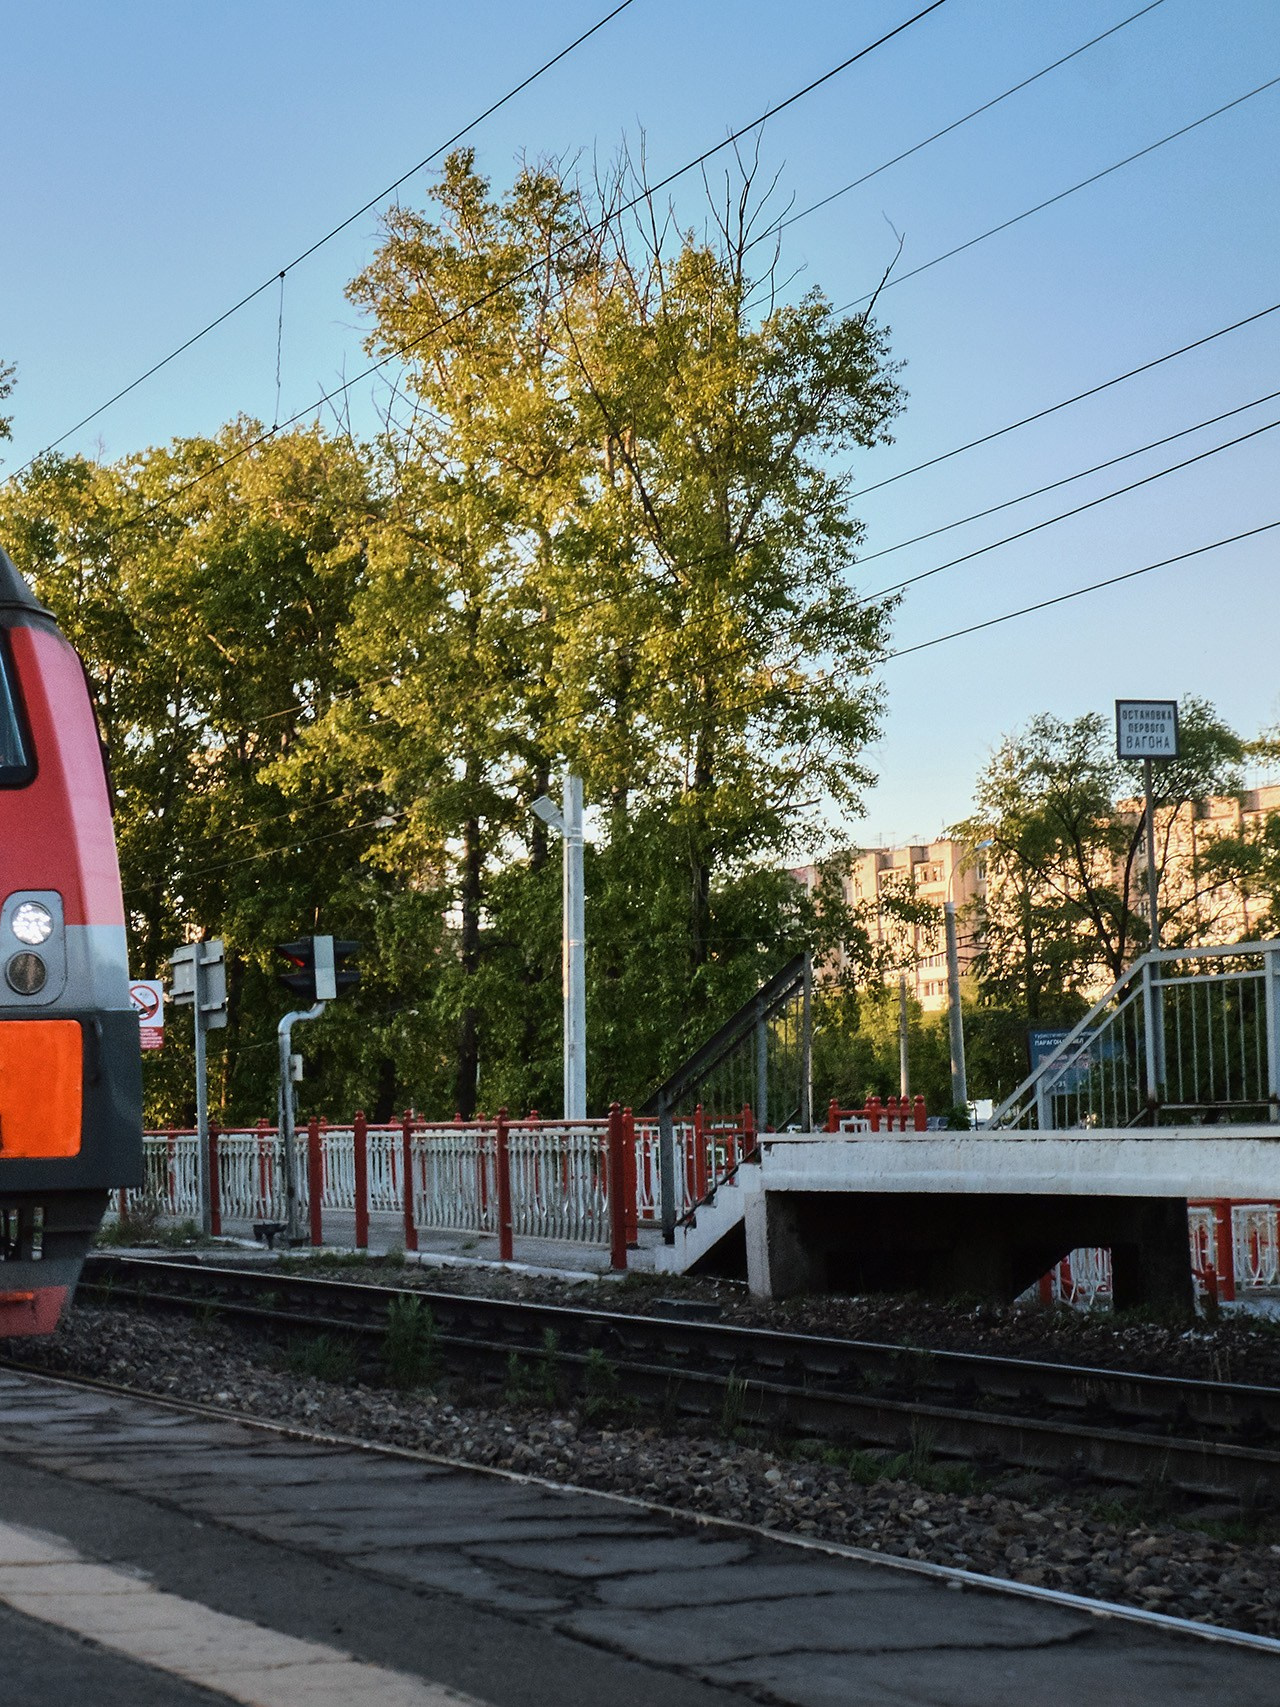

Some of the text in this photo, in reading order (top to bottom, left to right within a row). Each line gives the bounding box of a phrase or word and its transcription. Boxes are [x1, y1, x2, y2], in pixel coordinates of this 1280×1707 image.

[1122, 710, 1172, 720] ОСТАНОВКА
[1128, 723, 1165, 733] ПЕРВОГО
[1126, 736, 1170, 749] ВАГОНА
